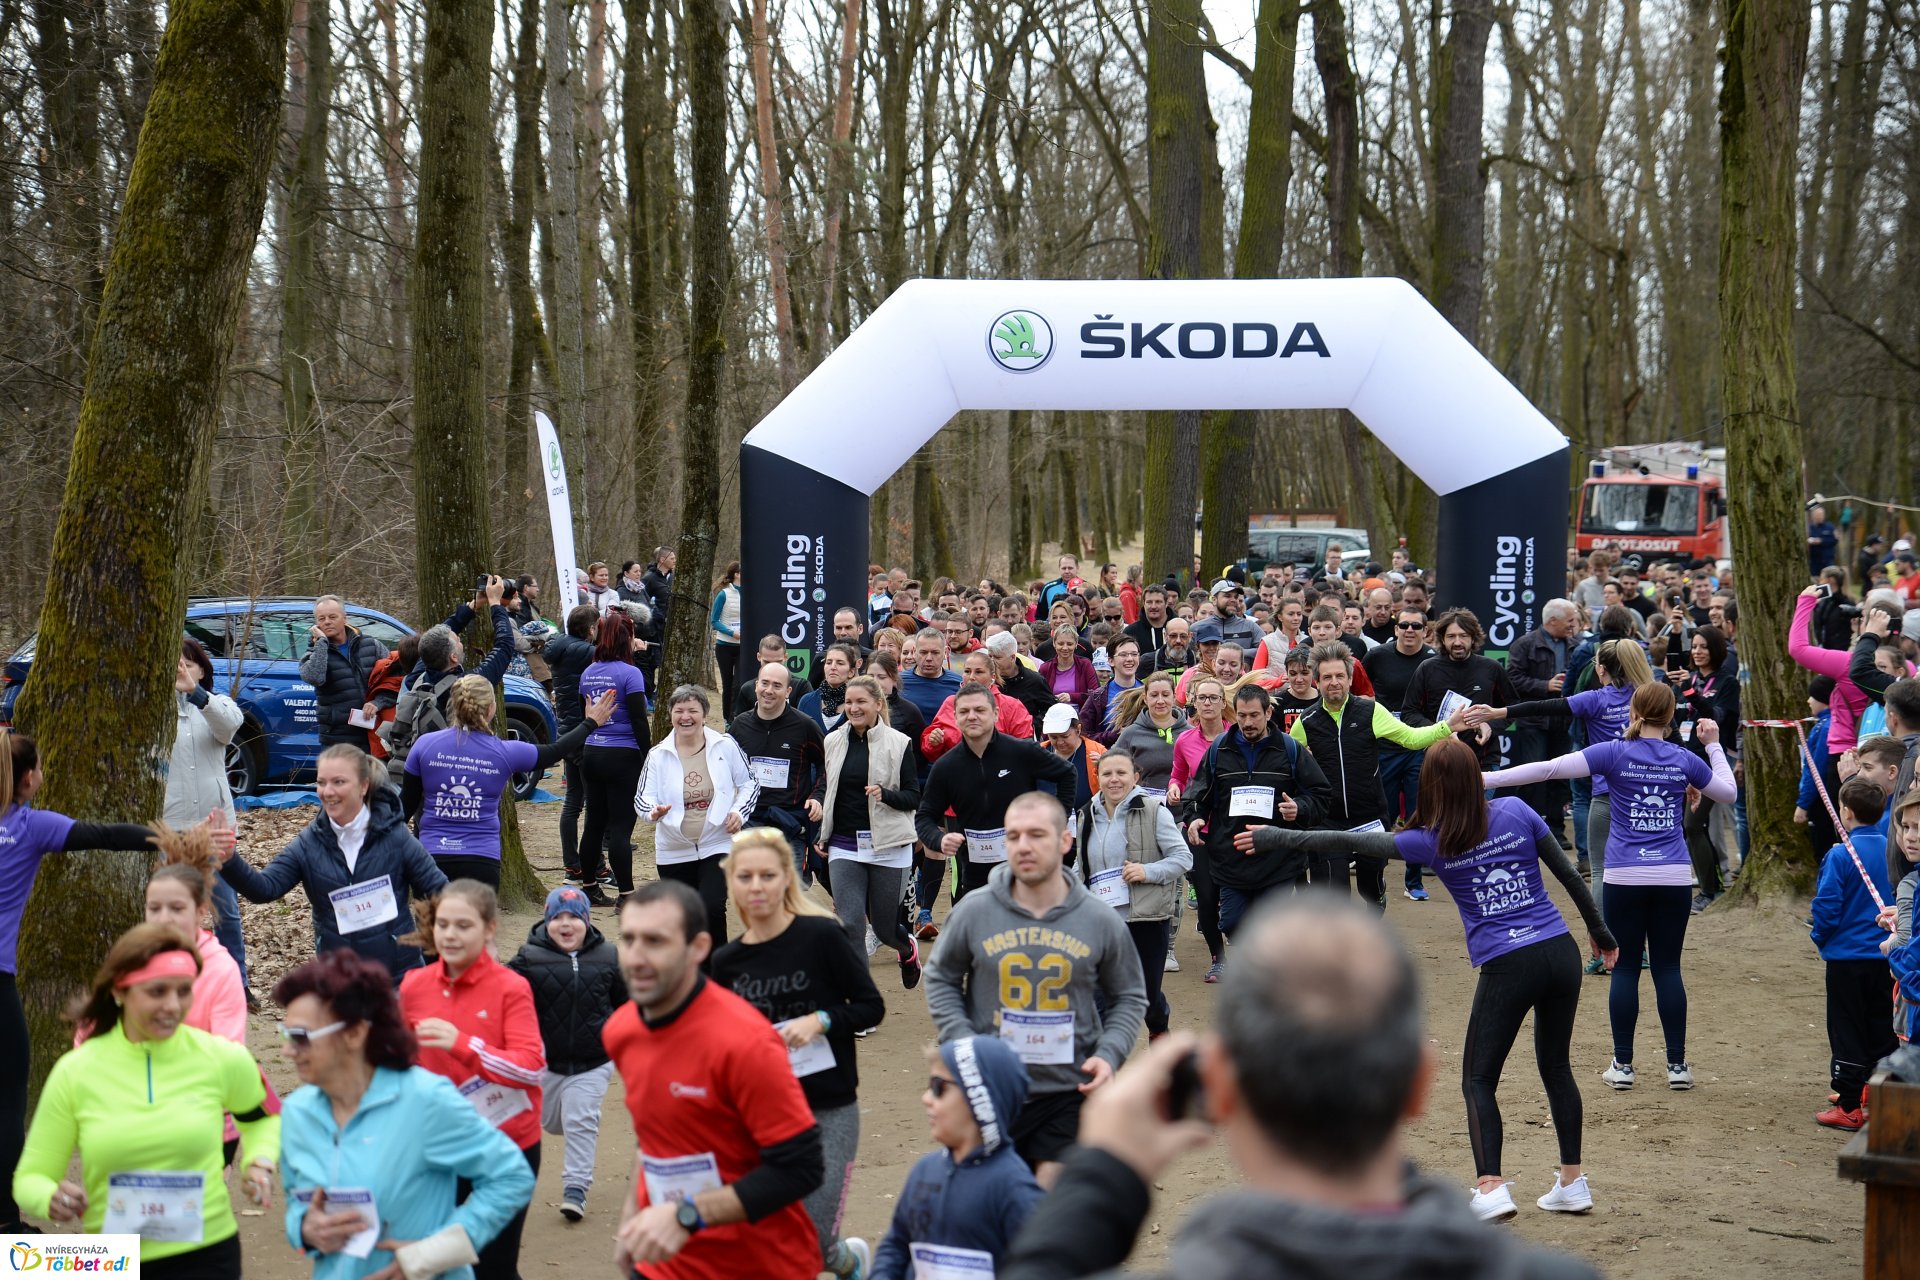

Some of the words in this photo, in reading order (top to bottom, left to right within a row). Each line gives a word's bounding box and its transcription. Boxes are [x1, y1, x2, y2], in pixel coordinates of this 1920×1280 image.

[1080, 313, 1332, 359] ŠKODA
[813, 535, 824, 584] ŠKODA
[1523, 537, 1534, 587] ŠKODA
[781, 534, 811, 645] Cycling
[1489, 536, 1522, 647] Cycling
[283, 699, 312, 707] VALENT
[428, 760, 454, 769] Jótékony
[1620, 770, 1645, 780] Jótékony
[1630, 806, 1675, 818] BÁTOR
[1493, 831, 1515, 845] értem.
[1444, 857, 1474, 870] Jótékony
[1475, 846, 1503, 860] sportoló
[1503, 835, 1527, 851] vagyok.
[1099, 886, 1112, 895] 292
[1475, 877, 1528, 903] BÁTOR
[1478, 888, 1531, 914] TÁBOR
[1519, 897, 1535, 907] camp
[355, 901, 372, 912] 314
[999, 952, 1073, 1011] 62
[1026, 1034, 1046, 1044] 164
[966, 1084, 997, 1123] STOP
